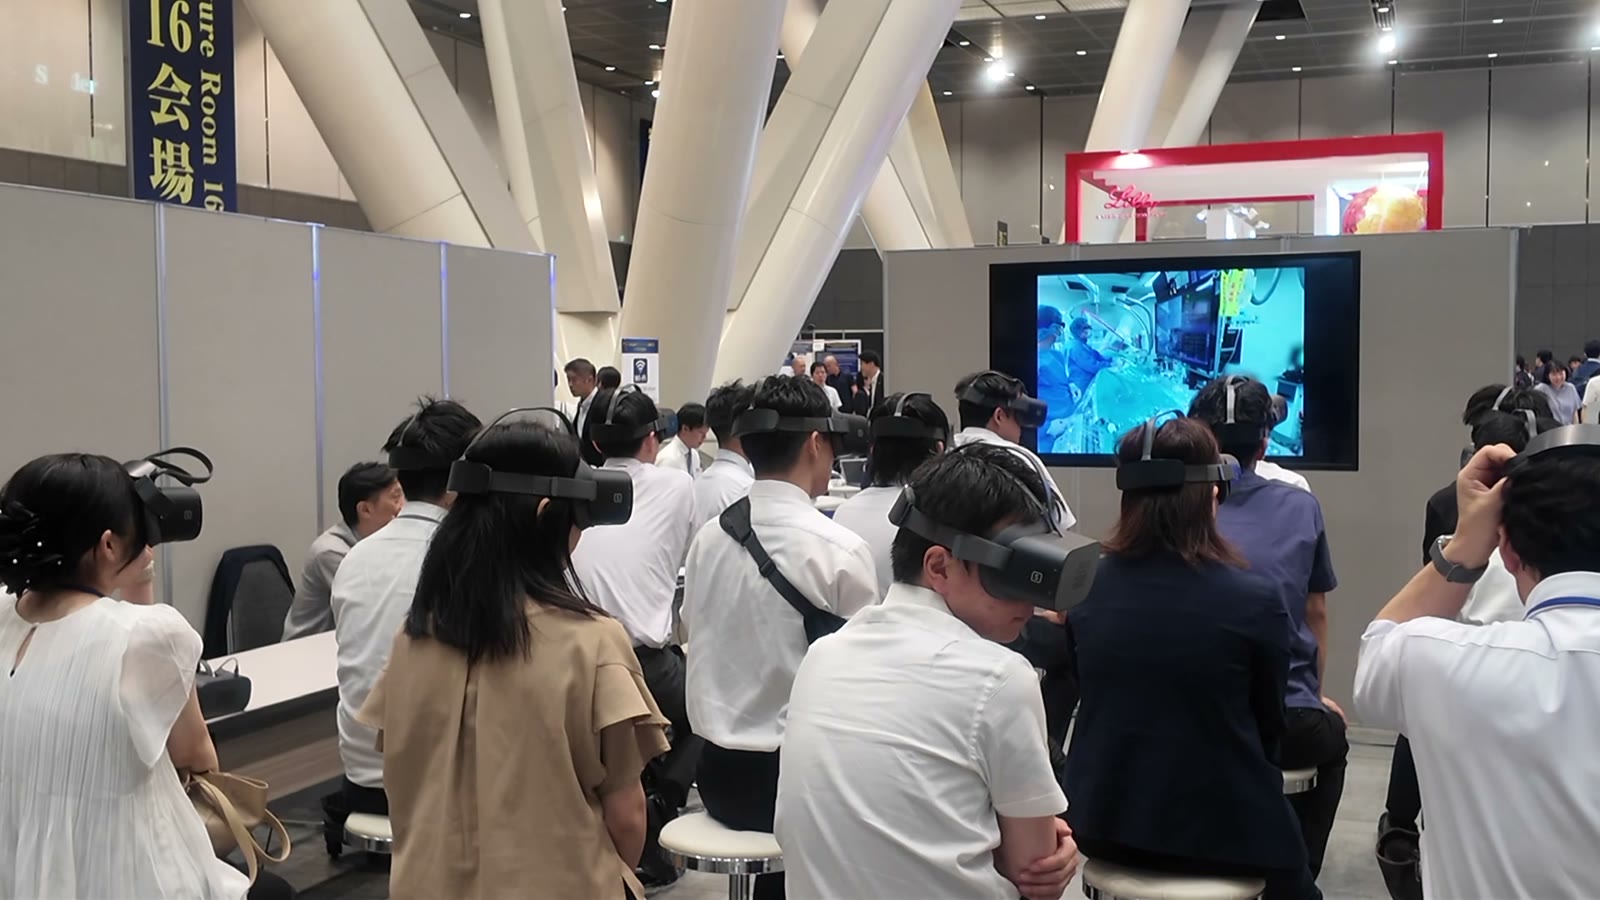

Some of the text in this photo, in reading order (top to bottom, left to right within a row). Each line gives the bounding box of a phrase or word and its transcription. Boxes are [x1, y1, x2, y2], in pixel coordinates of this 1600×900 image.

[199, 0, 224, 213] ure Room 16
